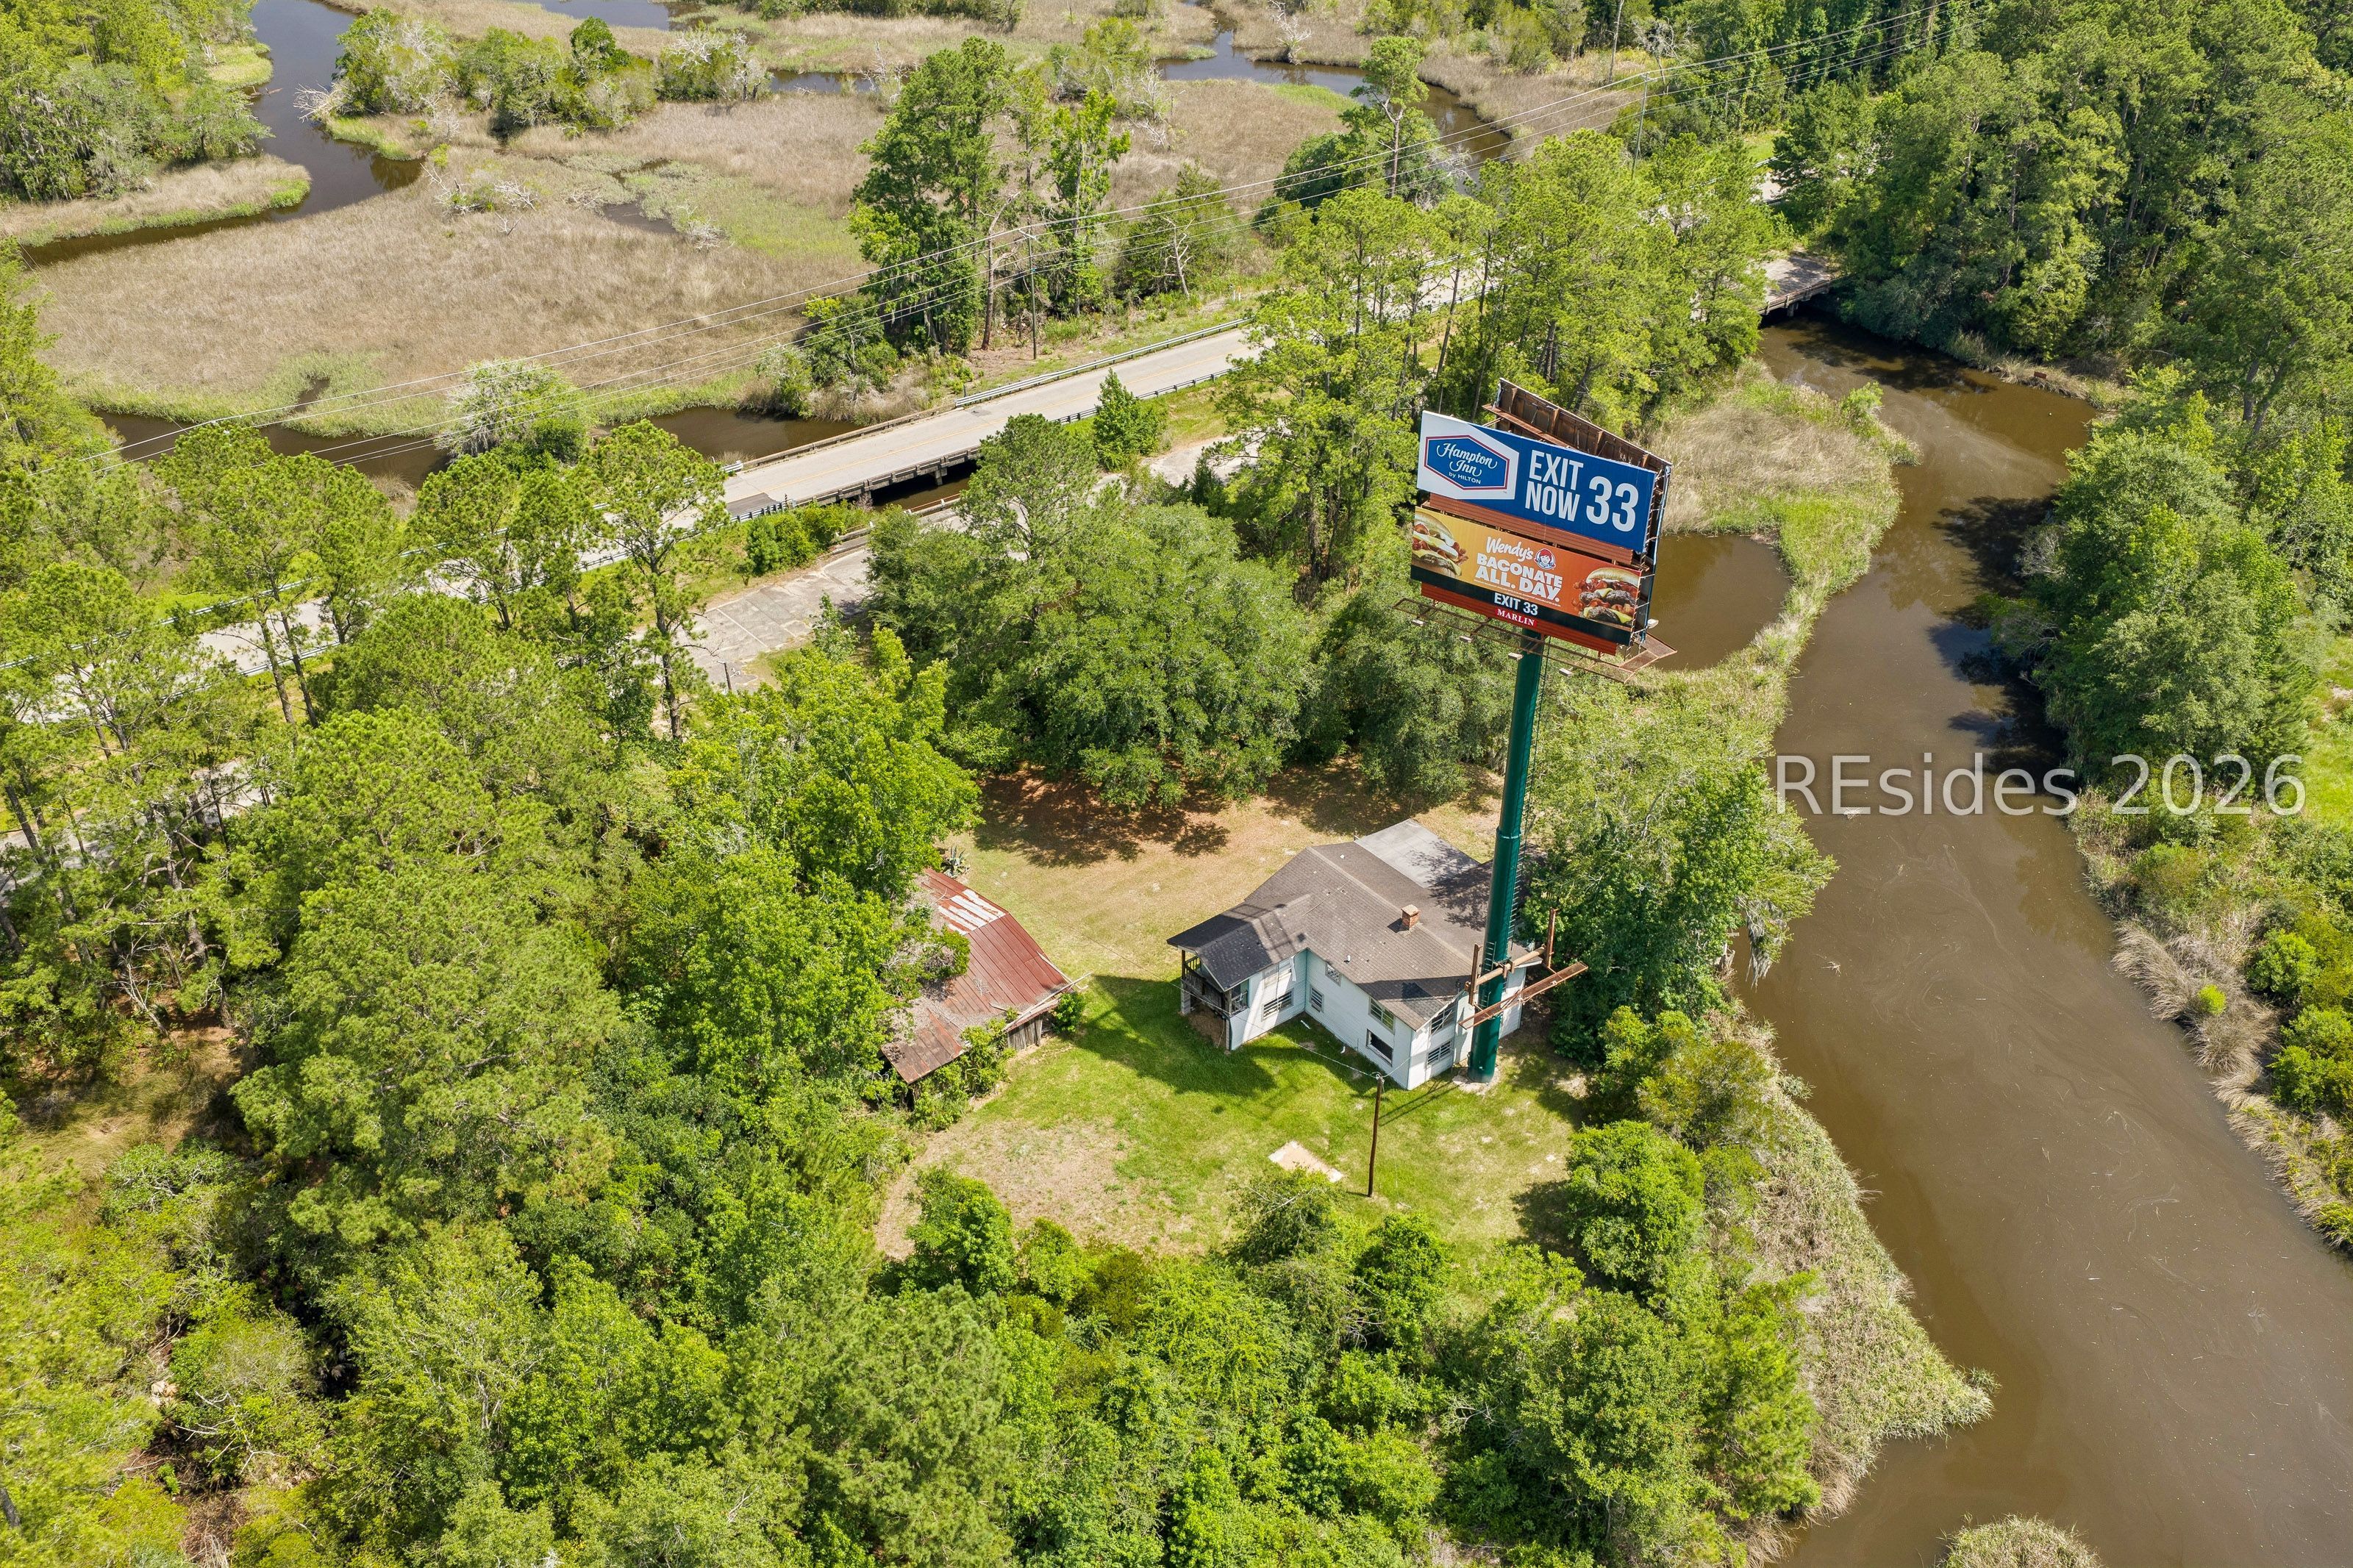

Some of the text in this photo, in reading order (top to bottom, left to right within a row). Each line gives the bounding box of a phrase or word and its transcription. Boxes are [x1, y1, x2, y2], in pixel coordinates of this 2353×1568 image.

[1437, 443, 1498, 469] Hampton
[1449, 459, 1482, 476] Inn
[1457, 474, 1481, 484] HILTON
[1529, 450, 1584, 490] EXIT
[1525, 476, 1639, 532] NOW 33
[1486, 537, 1534, 562] Wendy's
[1475, 565, 1515, 589] ALL.
[1519, 576, 1561, 602] DAY.
[1477, 553, 1563, 589] BACONATE
[1494, 593, 1521, 610] EXIT
[1523, 602, 1538, 615] 33
[1496, 608, 1535, 626] MARLIN
